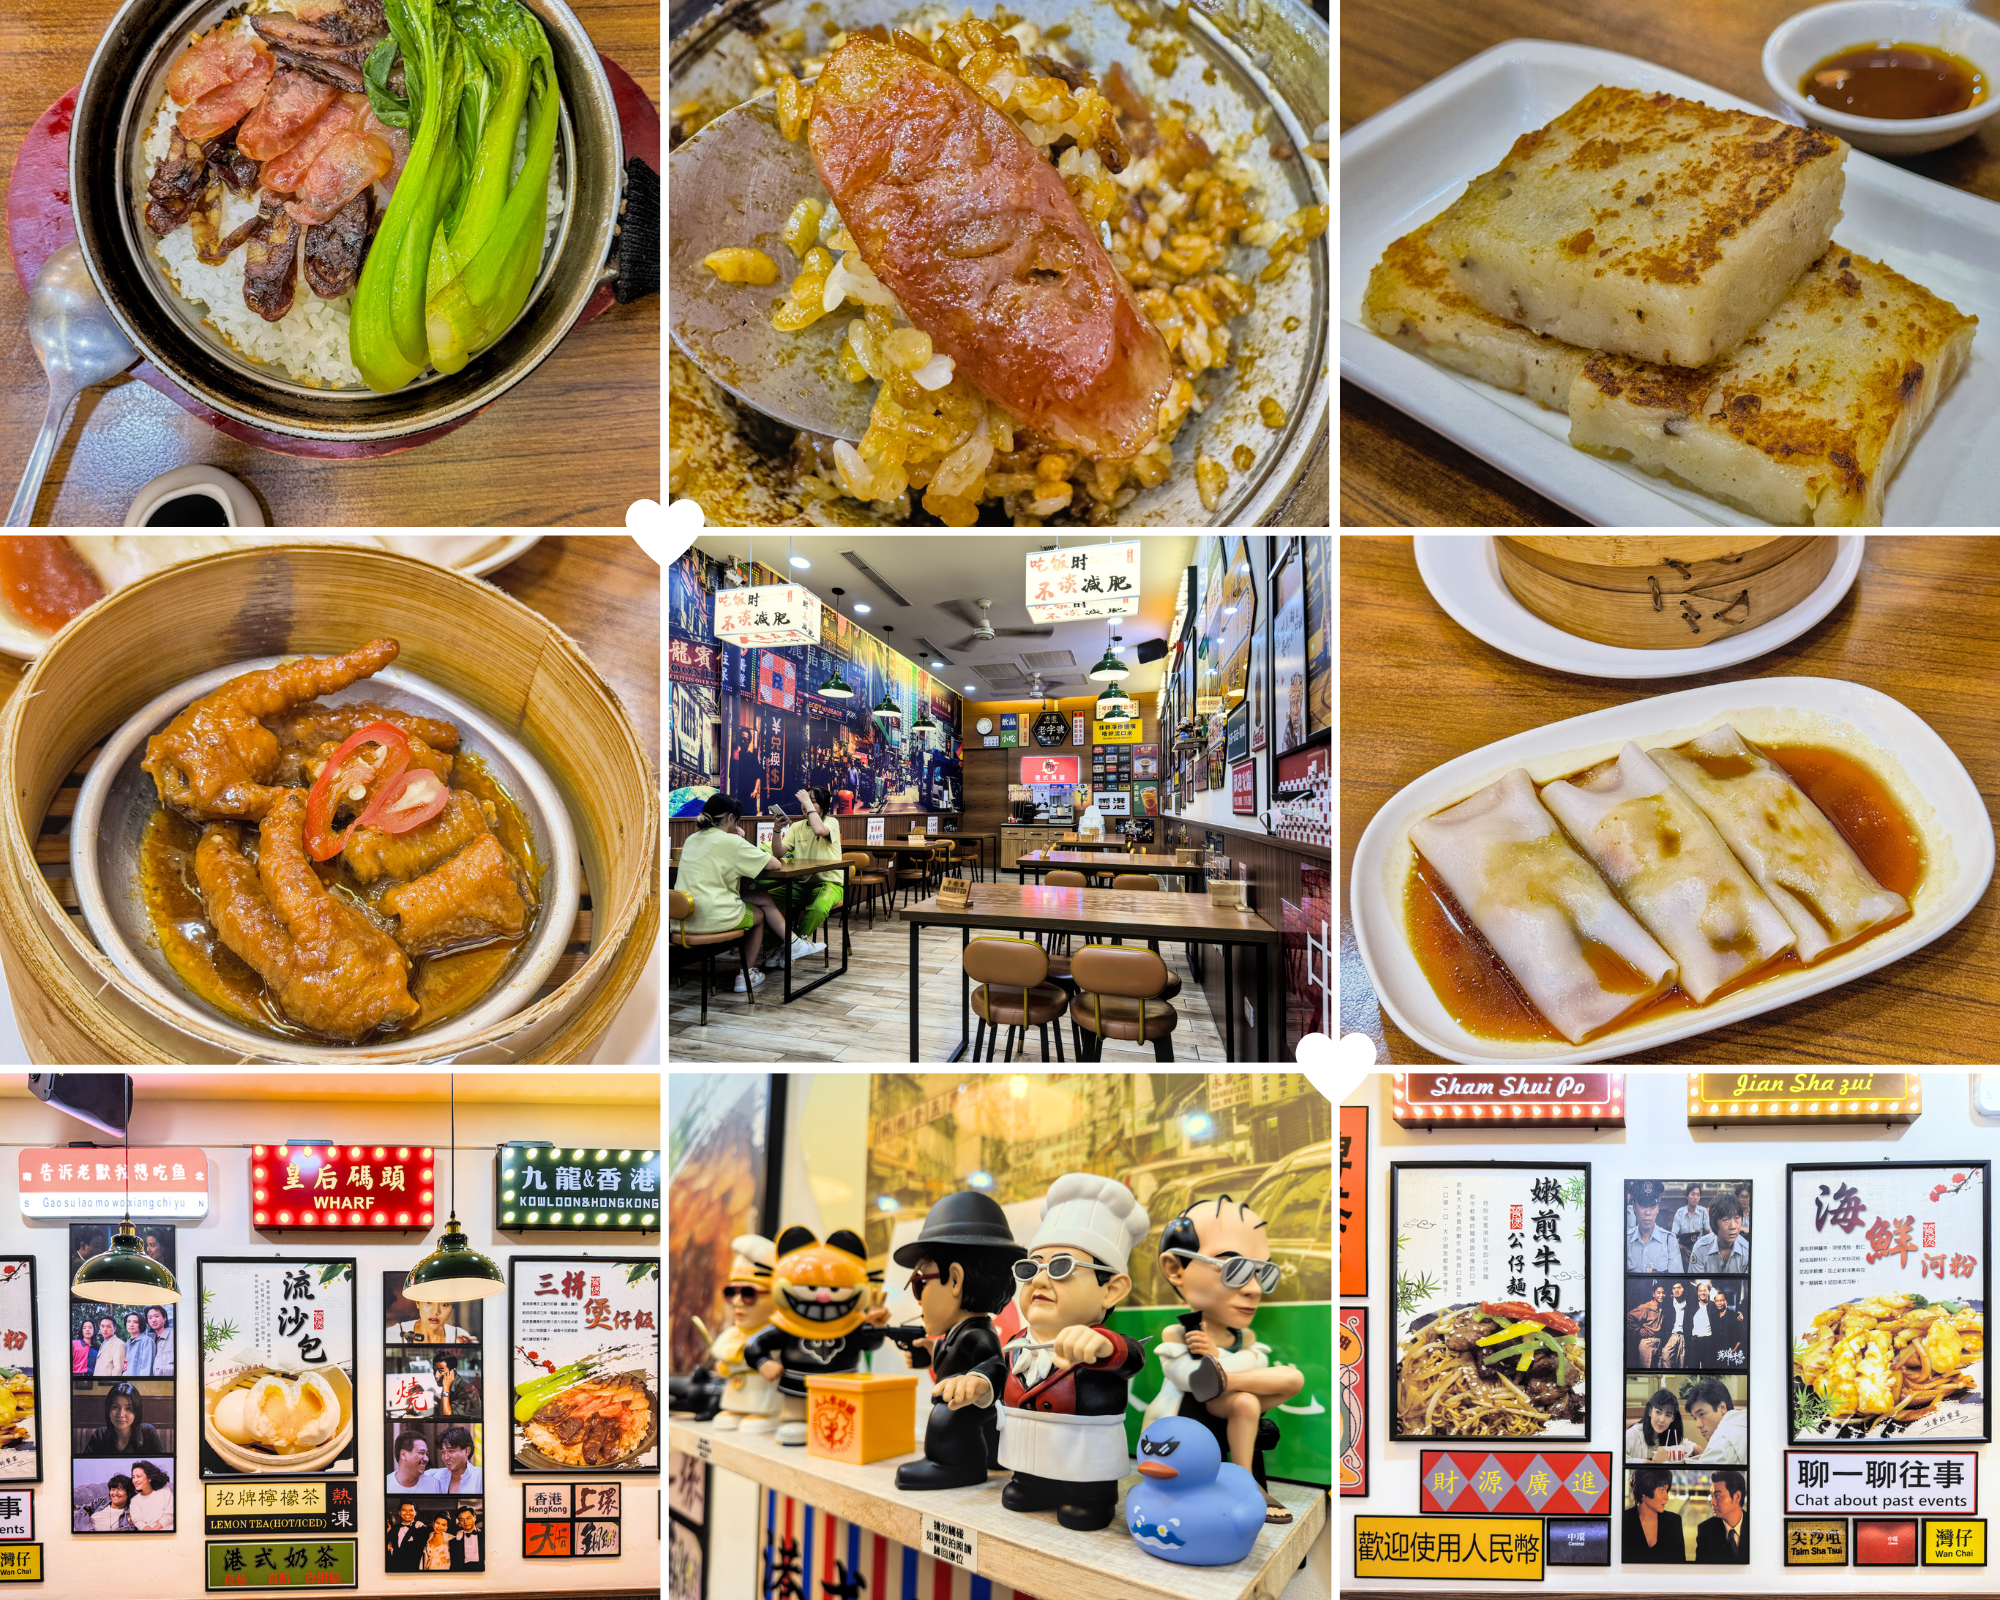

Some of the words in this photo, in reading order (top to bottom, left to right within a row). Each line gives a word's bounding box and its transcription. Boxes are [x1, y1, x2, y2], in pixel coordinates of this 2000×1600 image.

[1002, 718, 1016, 726] 飲品
[1001, 734, 1016, 743] 小吃
[942, 886, 967, 894] RESERVED
[1430, 1077, 1494, 1096] Sham
[1498, 1076, 1552, 1097] Shui
[1555, 1077, 1586, 1097] Po
[1733, 1074, 1784, 1097] Jian
[1789, 1074, 1836, 1093] Sha
[1839, 1073, 1873, 1095] zui
[40, 1162, 187, 1182] 告诉老默我想吃鱼
[194, 1171, 205, 1181] 北
[282, 1162, 406, 1191] 皇后碼頭
[521, 1165, 656, 1192] 九龍&香港
[24, 1199, 30, 1208] S
[43, 1197, 62, 1208] Gao
[64, 1199, 76, 1208] su
[78, 1197, 93, 1208] lao
[96, 1199, 110, 1208] mo
[112, 1199, 125, 1208] wo
[127, 1197, 154, 1209] xiang
[157, 1197, 172, 1208] chi
[174, 1199, 186, 1210] yu
[199, 1200, 205, 1208] N
[314, 1196, 375, 1209] WHARF
[520, 1196, 659, 1209] KOWLOON&HONGKONG
[1815, 1181, 1919, 1269] 海鮮
[1530, 1176, 1565, 1310] 嫩煎牛肉
[1507, 1232, 1527, 1297] 公仔麵
[1920, 1252, 1978, 1279] 河粉
[534, 1270, 586, 1300] 三拼
[278, 1269, 327, 1363] 流沙包
[583, 1297, 656, 1330] 煲仔飯
[0, 1329, 28, 1350] 粉
[395, 1376, 428, 1411] 燒
[1431, 1469, 1600, 1497] 財源廣進
[1797, 1459, 1965, 1489] 聊一聊往事
[216, 1487, 320, 1508] 招牌檸檬茶
[534, 1491, 562, 1506] 香港
[1795, 1493, 1829, 1507] Chat
[1834, 1493, 1878, 1507] about
[1882, 1494, 1915, 1510] past
[1918, 1495, 1967, 1507] events
[210, 1519, 247, 1529] LEMON
[249, 1518, 327, 1529] TEA(HOT/ICED)
[1357, 1530, 1540, 1565] 歡迎使用人民幣
[1791, 1529, 1842, 1546] 尖沙咀
[1935, 1528, 1973, 1548] 灣仔
[224, 1544, 339, 1572] 港式奶茶
[1791, 1547, 1810, 1556] Tsim
[1811, 1547, 1826, 1555] Sha
[1827, 1546, 1843, 1555] Tsui
[1935, 1550, 1953, 1558] Wan
[1955, 1549, 1973, 1558] Chai
[16, 1567, 32, 1575] Chai
[224, 1573, 247, 1586] 真茶
[267, 1572, 290, 1585] 真奶
[304, 1571, 342, 1584] 真港味
